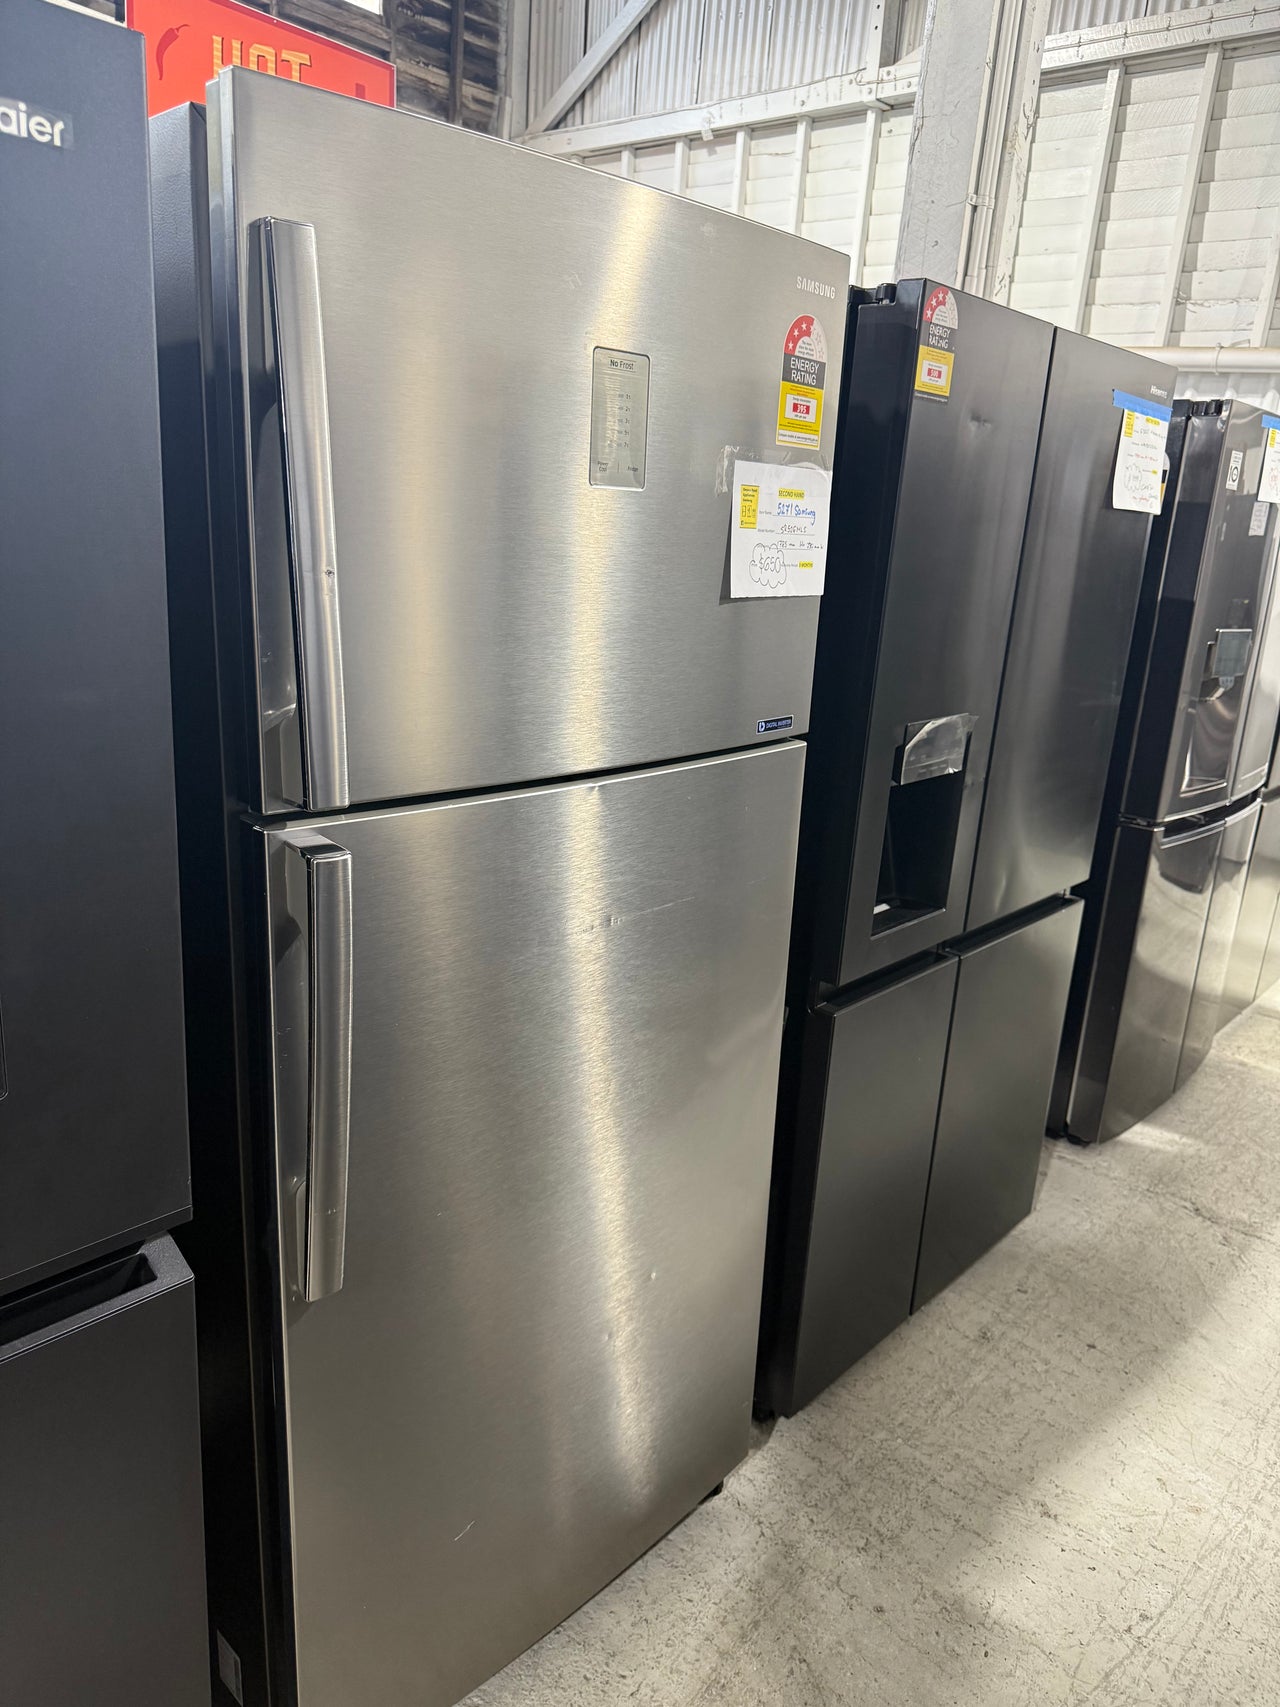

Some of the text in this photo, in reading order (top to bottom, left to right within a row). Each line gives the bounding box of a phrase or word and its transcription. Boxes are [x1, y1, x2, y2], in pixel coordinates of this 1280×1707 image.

[796, 276, 836, 299] SAMSUNG
[929, 324, 951, 339] ENERGY
[929, 334, 949, 349] RATING
[610, 359, 634, 370] No Frost
[790, 357, 820, 374] ENERGY
[791, 370, 817, 386] RATING
[778, 489, 794, 498] SECOND
[758, 553, 781, 574] $650
